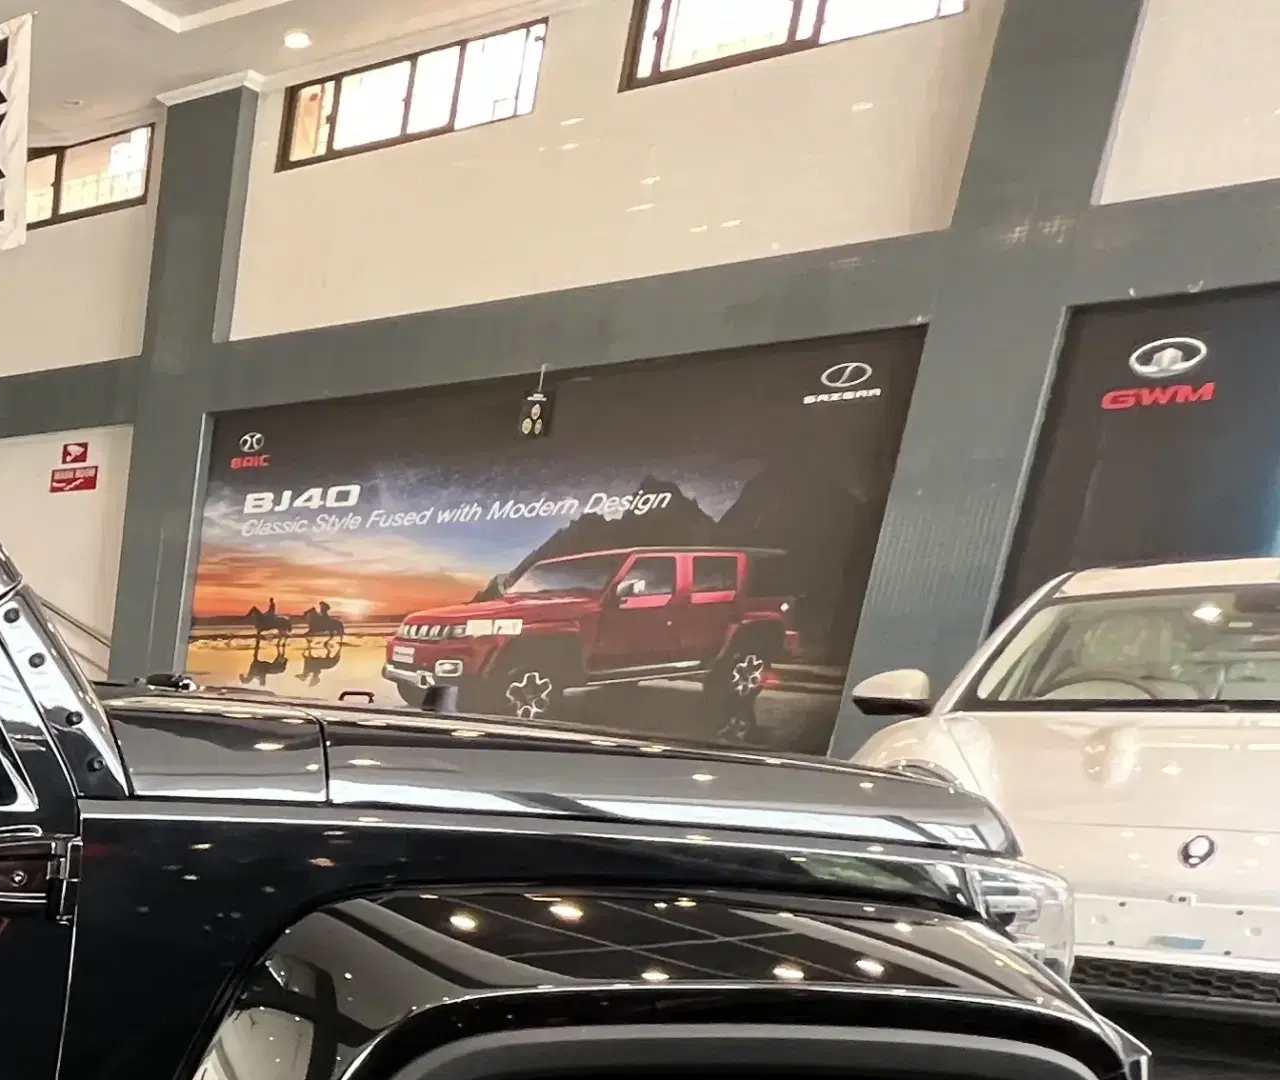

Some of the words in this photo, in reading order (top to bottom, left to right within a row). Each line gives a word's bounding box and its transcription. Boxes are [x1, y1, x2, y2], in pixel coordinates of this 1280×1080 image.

[1101, 381, 1216, 410] GWM
[241, 516, 310, 537] Classic
[312, 512, 363, 535] Style
[366, 507, 435, 529] Fused
[436, 502, 483, 525] with
[486, 498, 580, 521] Modern
[583, 490, 673, 515] Design
[243, 484, 362, 514] BJ40
